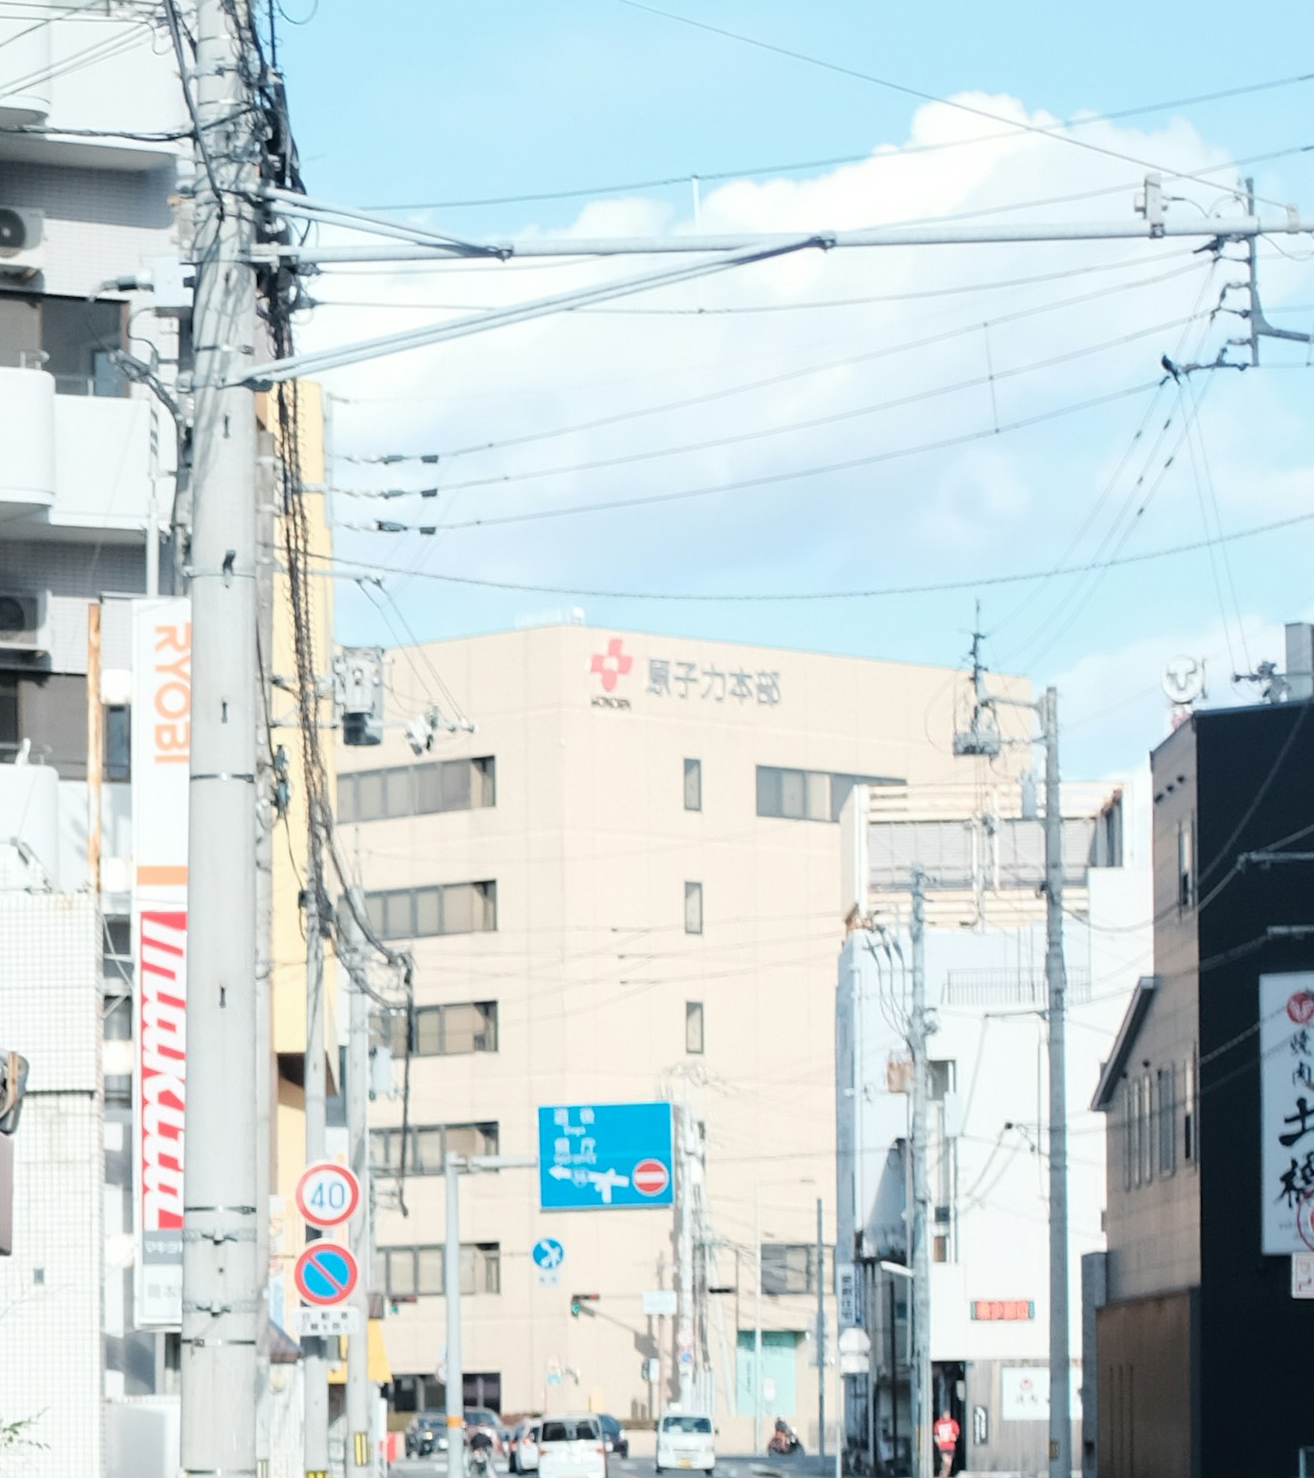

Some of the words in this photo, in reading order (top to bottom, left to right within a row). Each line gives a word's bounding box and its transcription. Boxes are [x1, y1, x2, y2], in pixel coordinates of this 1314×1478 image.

[154, 621, 190, 764] RYOBI
[646, 658, 781, 707] 原子力本部
[310, 1181, 346, 1210] 40
